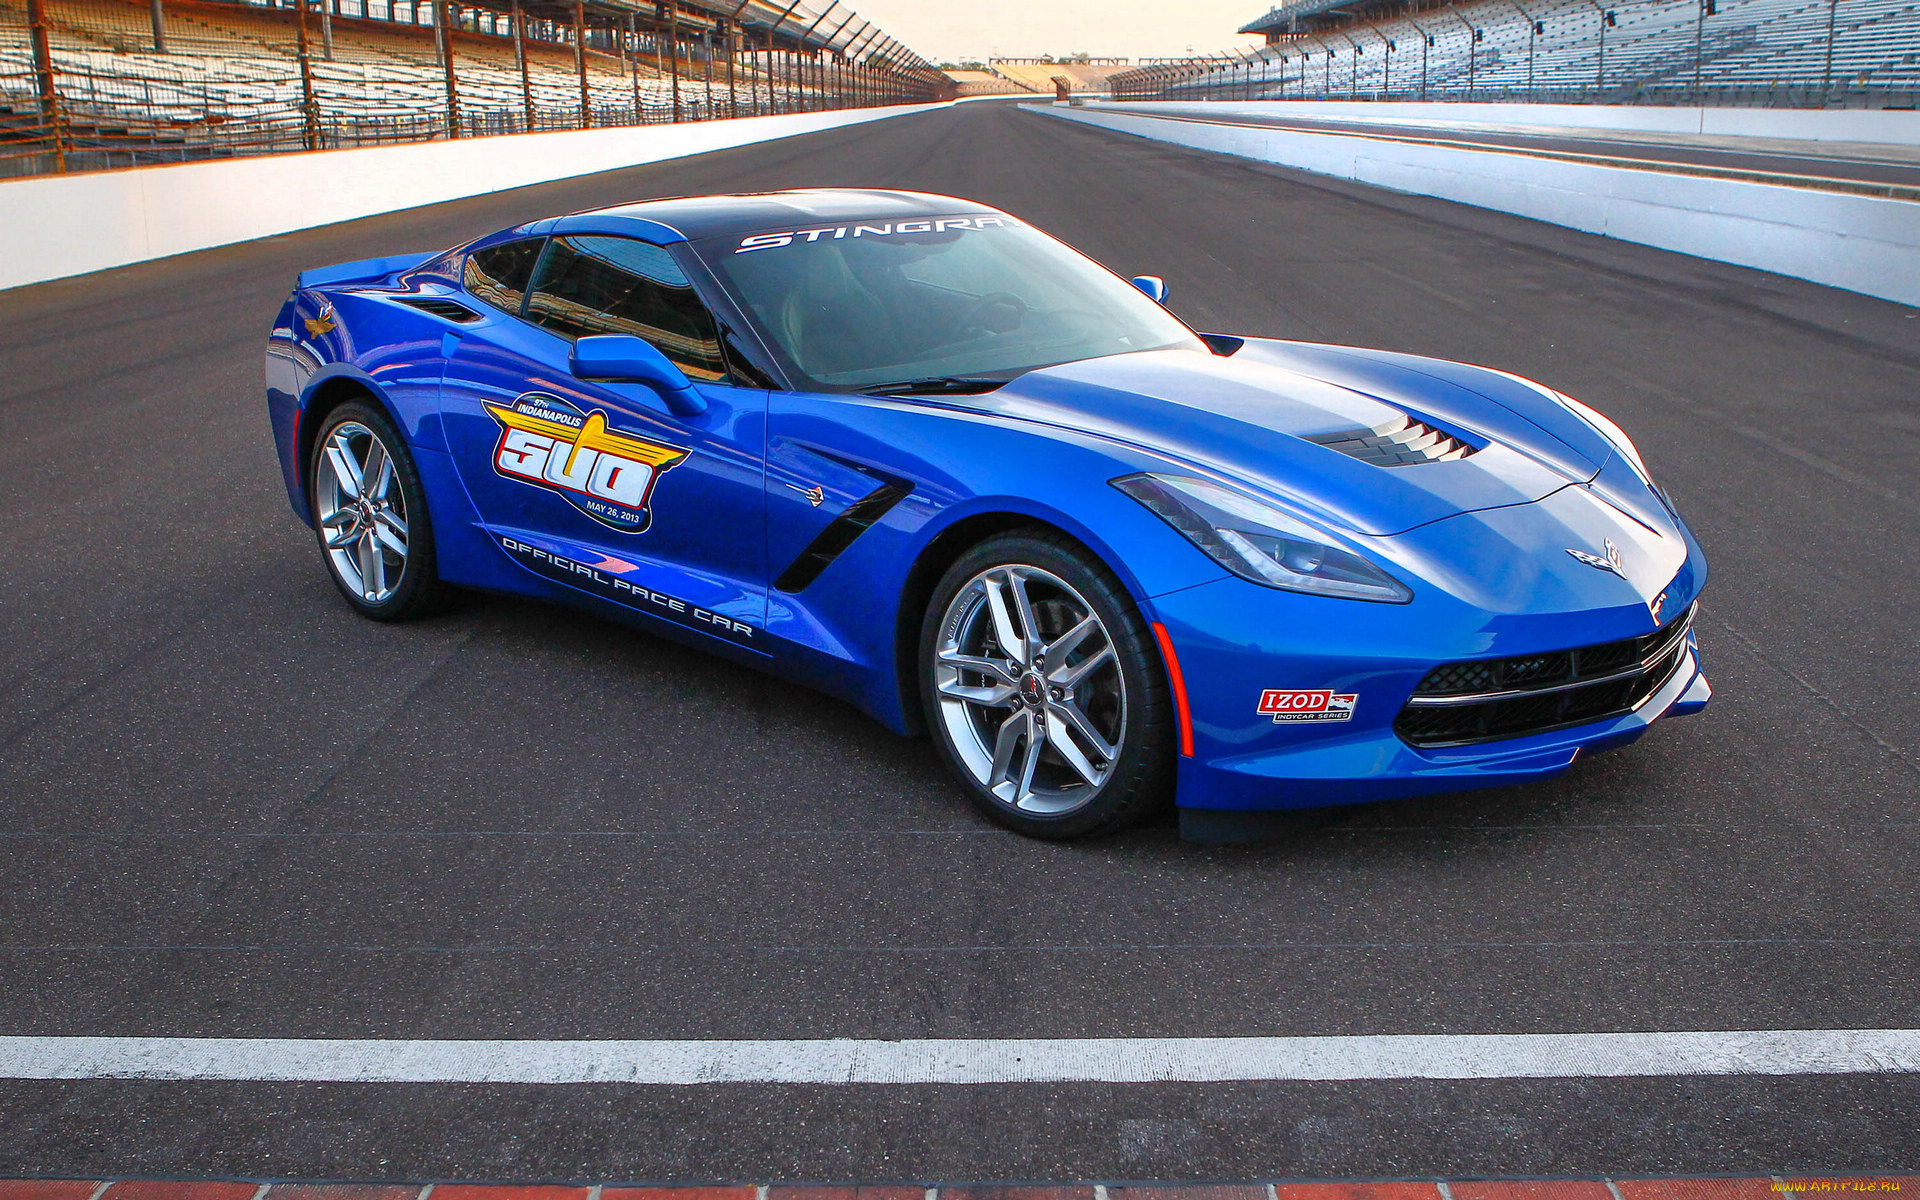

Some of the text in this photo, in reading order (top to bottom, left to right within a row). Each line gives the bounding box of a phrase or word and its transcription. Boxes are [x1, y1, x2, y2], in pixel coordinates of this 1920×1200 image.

[517, 403, 582, 427] INDIANAPOLIS
[586, 500, 640, 523] MAY 26, 2013
[502, 537, 752, 637] OFFICIAL PACE CAR
[1265, 694, 1325, 709] IZOD
